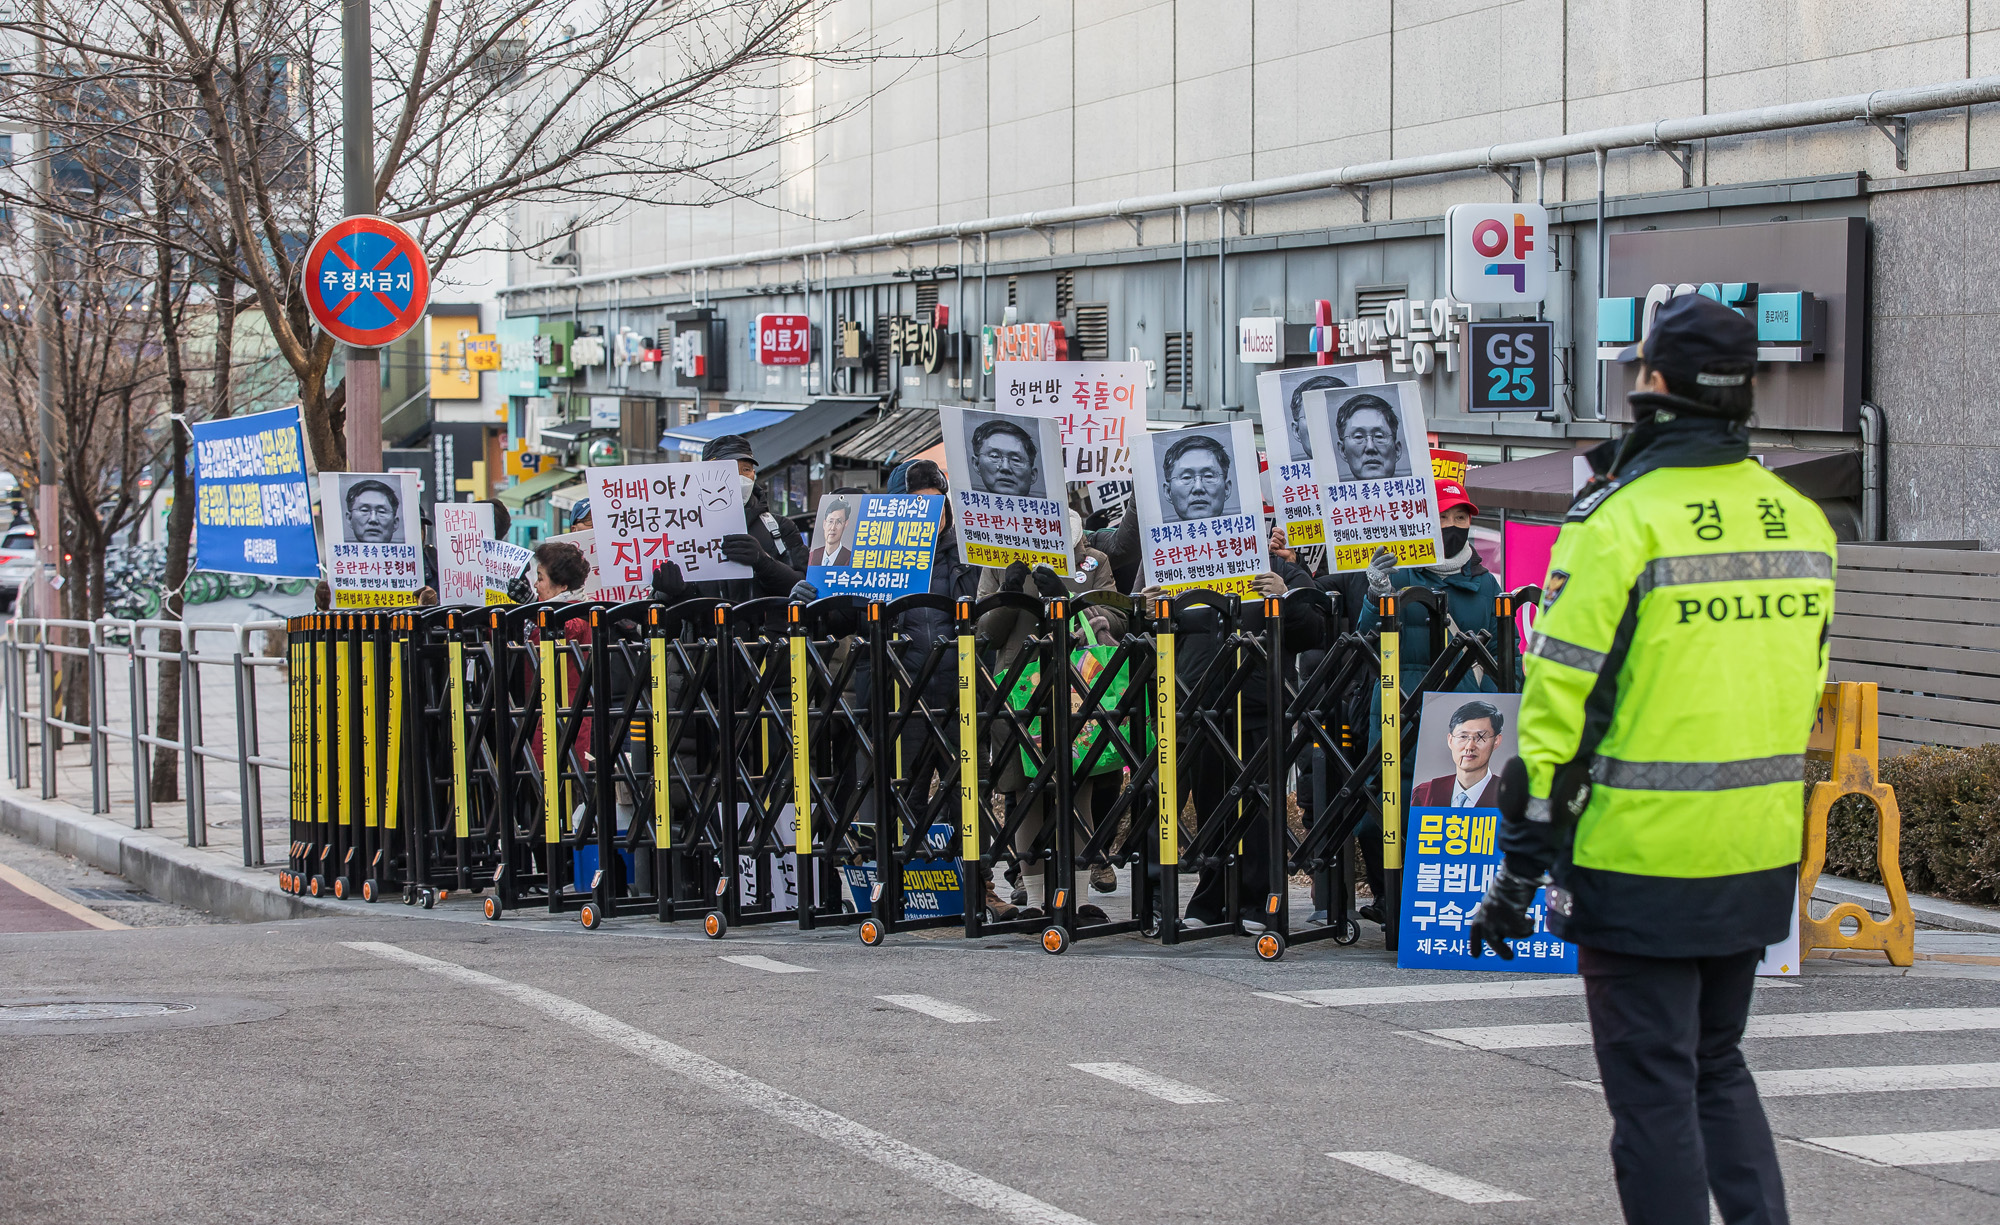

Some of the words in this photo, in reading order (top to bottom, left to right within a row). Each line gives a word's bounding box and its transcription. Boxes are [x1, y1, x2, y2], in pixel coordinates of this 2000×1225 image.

[1472, 213, 1534, 293] 약
[323, 271, 410, 291] 주정차금지
[763, 329, 807, 352] 의료기
[1386, 298, 1471, 374] 일등약
[1486, 333, 1536, 366] GS
[1010, 379, 1062, 407] 행번방
[1072, 381, 1135, 410] 죽돌이
[1487, 367, 1536, 401] 25
[521, 452, 541, 473] 약
[1383, 477, 1426, 498] 탄핵심리
[867, 498, 930, 518] 민노총하수인
[1018, 498, 1060, 517] 탄핵심리
[443, 508, 477, 533] 음란수괴
[1211, 514, 1256, 536] 탄핵심리
[1288, 522, 1324, 541] 우리법회
[856, 521, 894, 546] 문형배
[894, 521, 935, 547] 재판관
[381, 545, 416, 559] 탄핵심리
[852, 550, 931, 570] 불법내란주동
[824, 571, 910, 588] 구속수사하라!
[1235, 579, 1257, 595] 다르
[1677, 593, 1820, 624] POLICE
[791, 677, 799, 760] POLICE
[1158, 675, 1168, 764] POLICE
[1381, 675, 1396, 844] 질서유지선
[794, 776, 802, 831] LINE
[1160, 781, 1169, 840] LINE
[1418, 815, 1497, 856] 문형배
[847, 869, 867, 888] 내란
[1417, 863, 1503, 893] 불법내
[904, 892, 940, 910] 사하라
